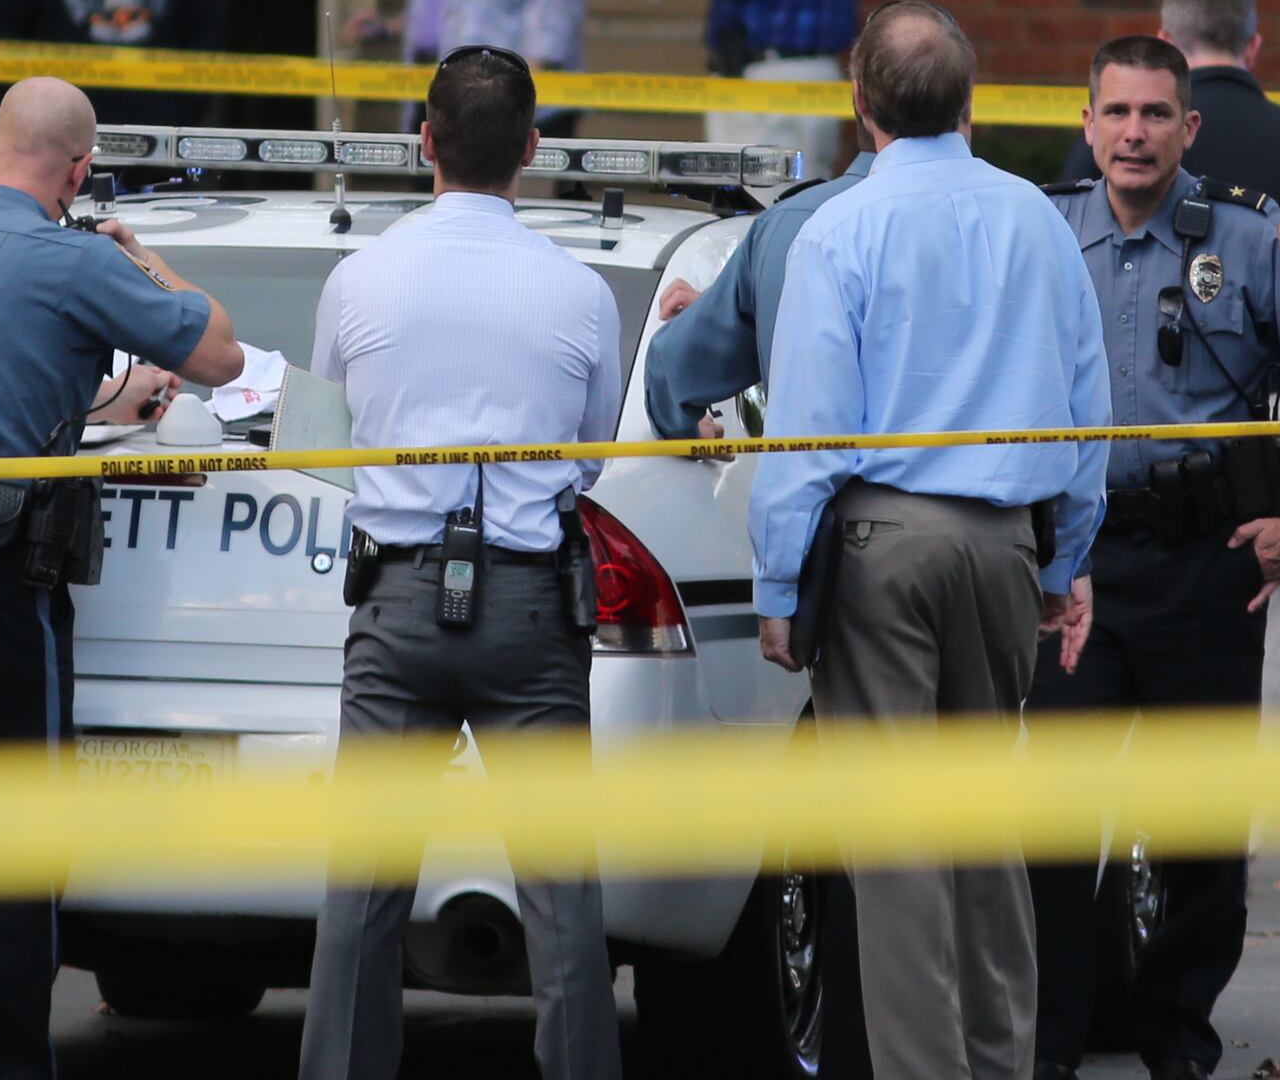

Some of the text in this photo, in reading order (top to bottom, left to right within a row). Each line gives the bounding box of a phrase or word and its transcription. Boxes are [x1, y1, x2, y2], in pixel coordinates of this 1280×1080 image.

[101, 457, 268, 476] POLICE LINE DO NOT CROSS
[396, 450, 562, 465] POLICE LINE DO NOT CROSS
[82, 738, 178, 759] GEORGIA
